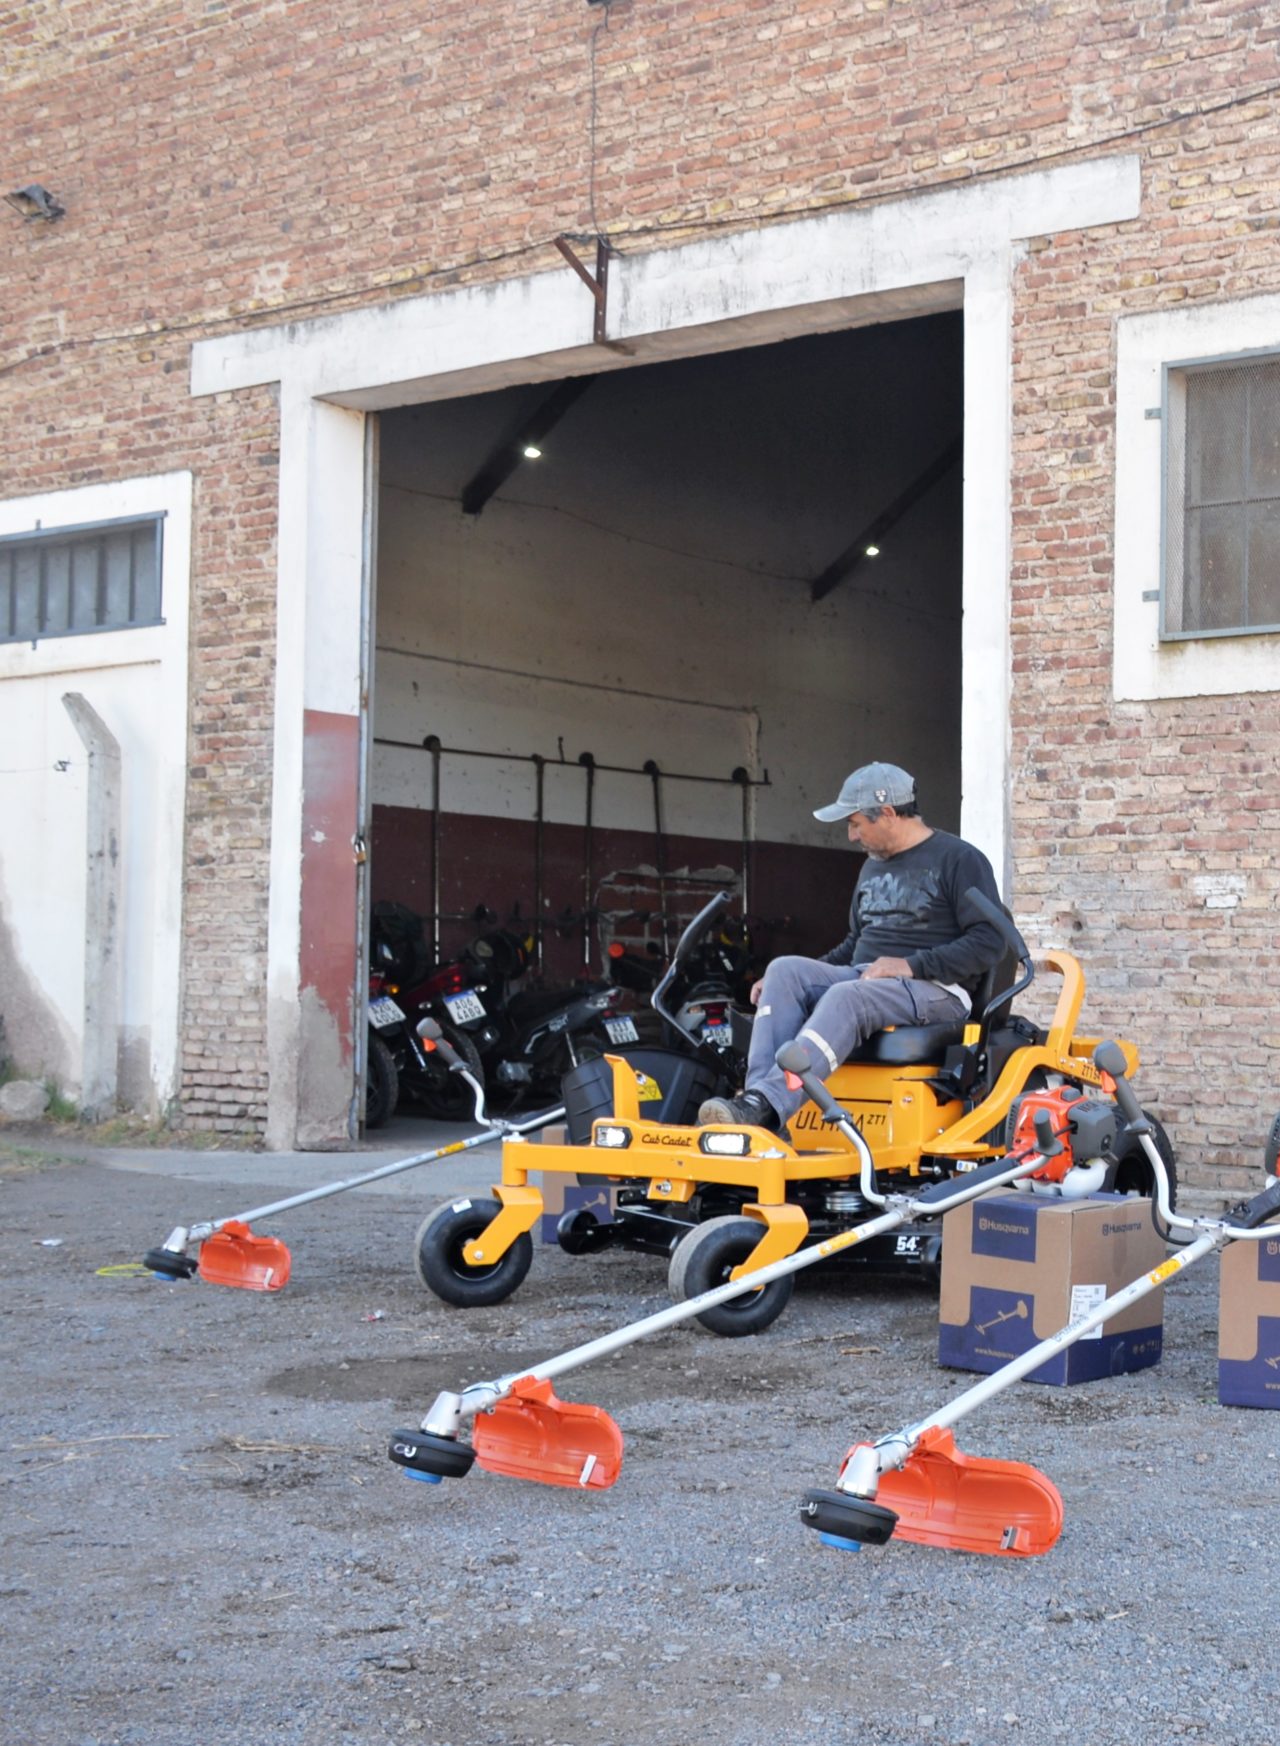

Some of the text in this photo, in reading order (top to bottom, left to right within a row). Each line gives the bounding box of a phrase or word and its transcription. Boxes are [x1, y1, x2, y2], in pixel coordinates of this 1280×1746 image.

[795, 1110, 887, 1133] ULA ZT1
[641, 1133, 693, 1147] Cub Cadet
[987, 1221, 1029, 1236] Husqvarna
[1109, 1221, 1142, 1235] Husqvarna
